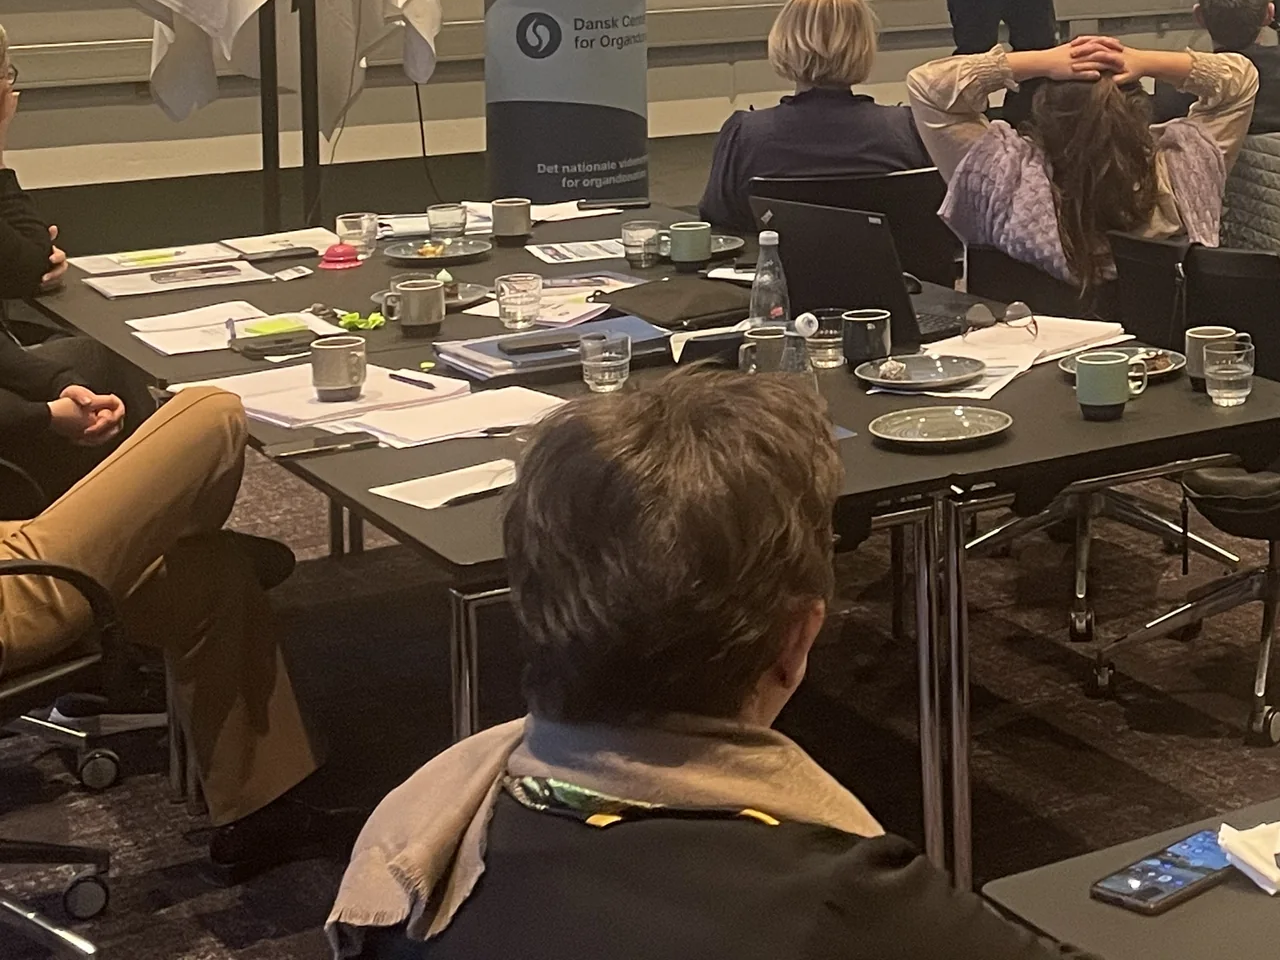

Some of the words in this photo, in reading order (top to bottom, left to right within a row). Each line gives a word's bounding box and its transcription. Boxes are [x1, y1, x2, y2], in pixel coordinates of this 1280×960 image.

[574, 16, 619, 31] Dansk
[575, 35, 596, 49] for
[537, 163, 559, 174] Det
[561, 160, 617, 174] nationale
[561, 176, 580, 188] for
